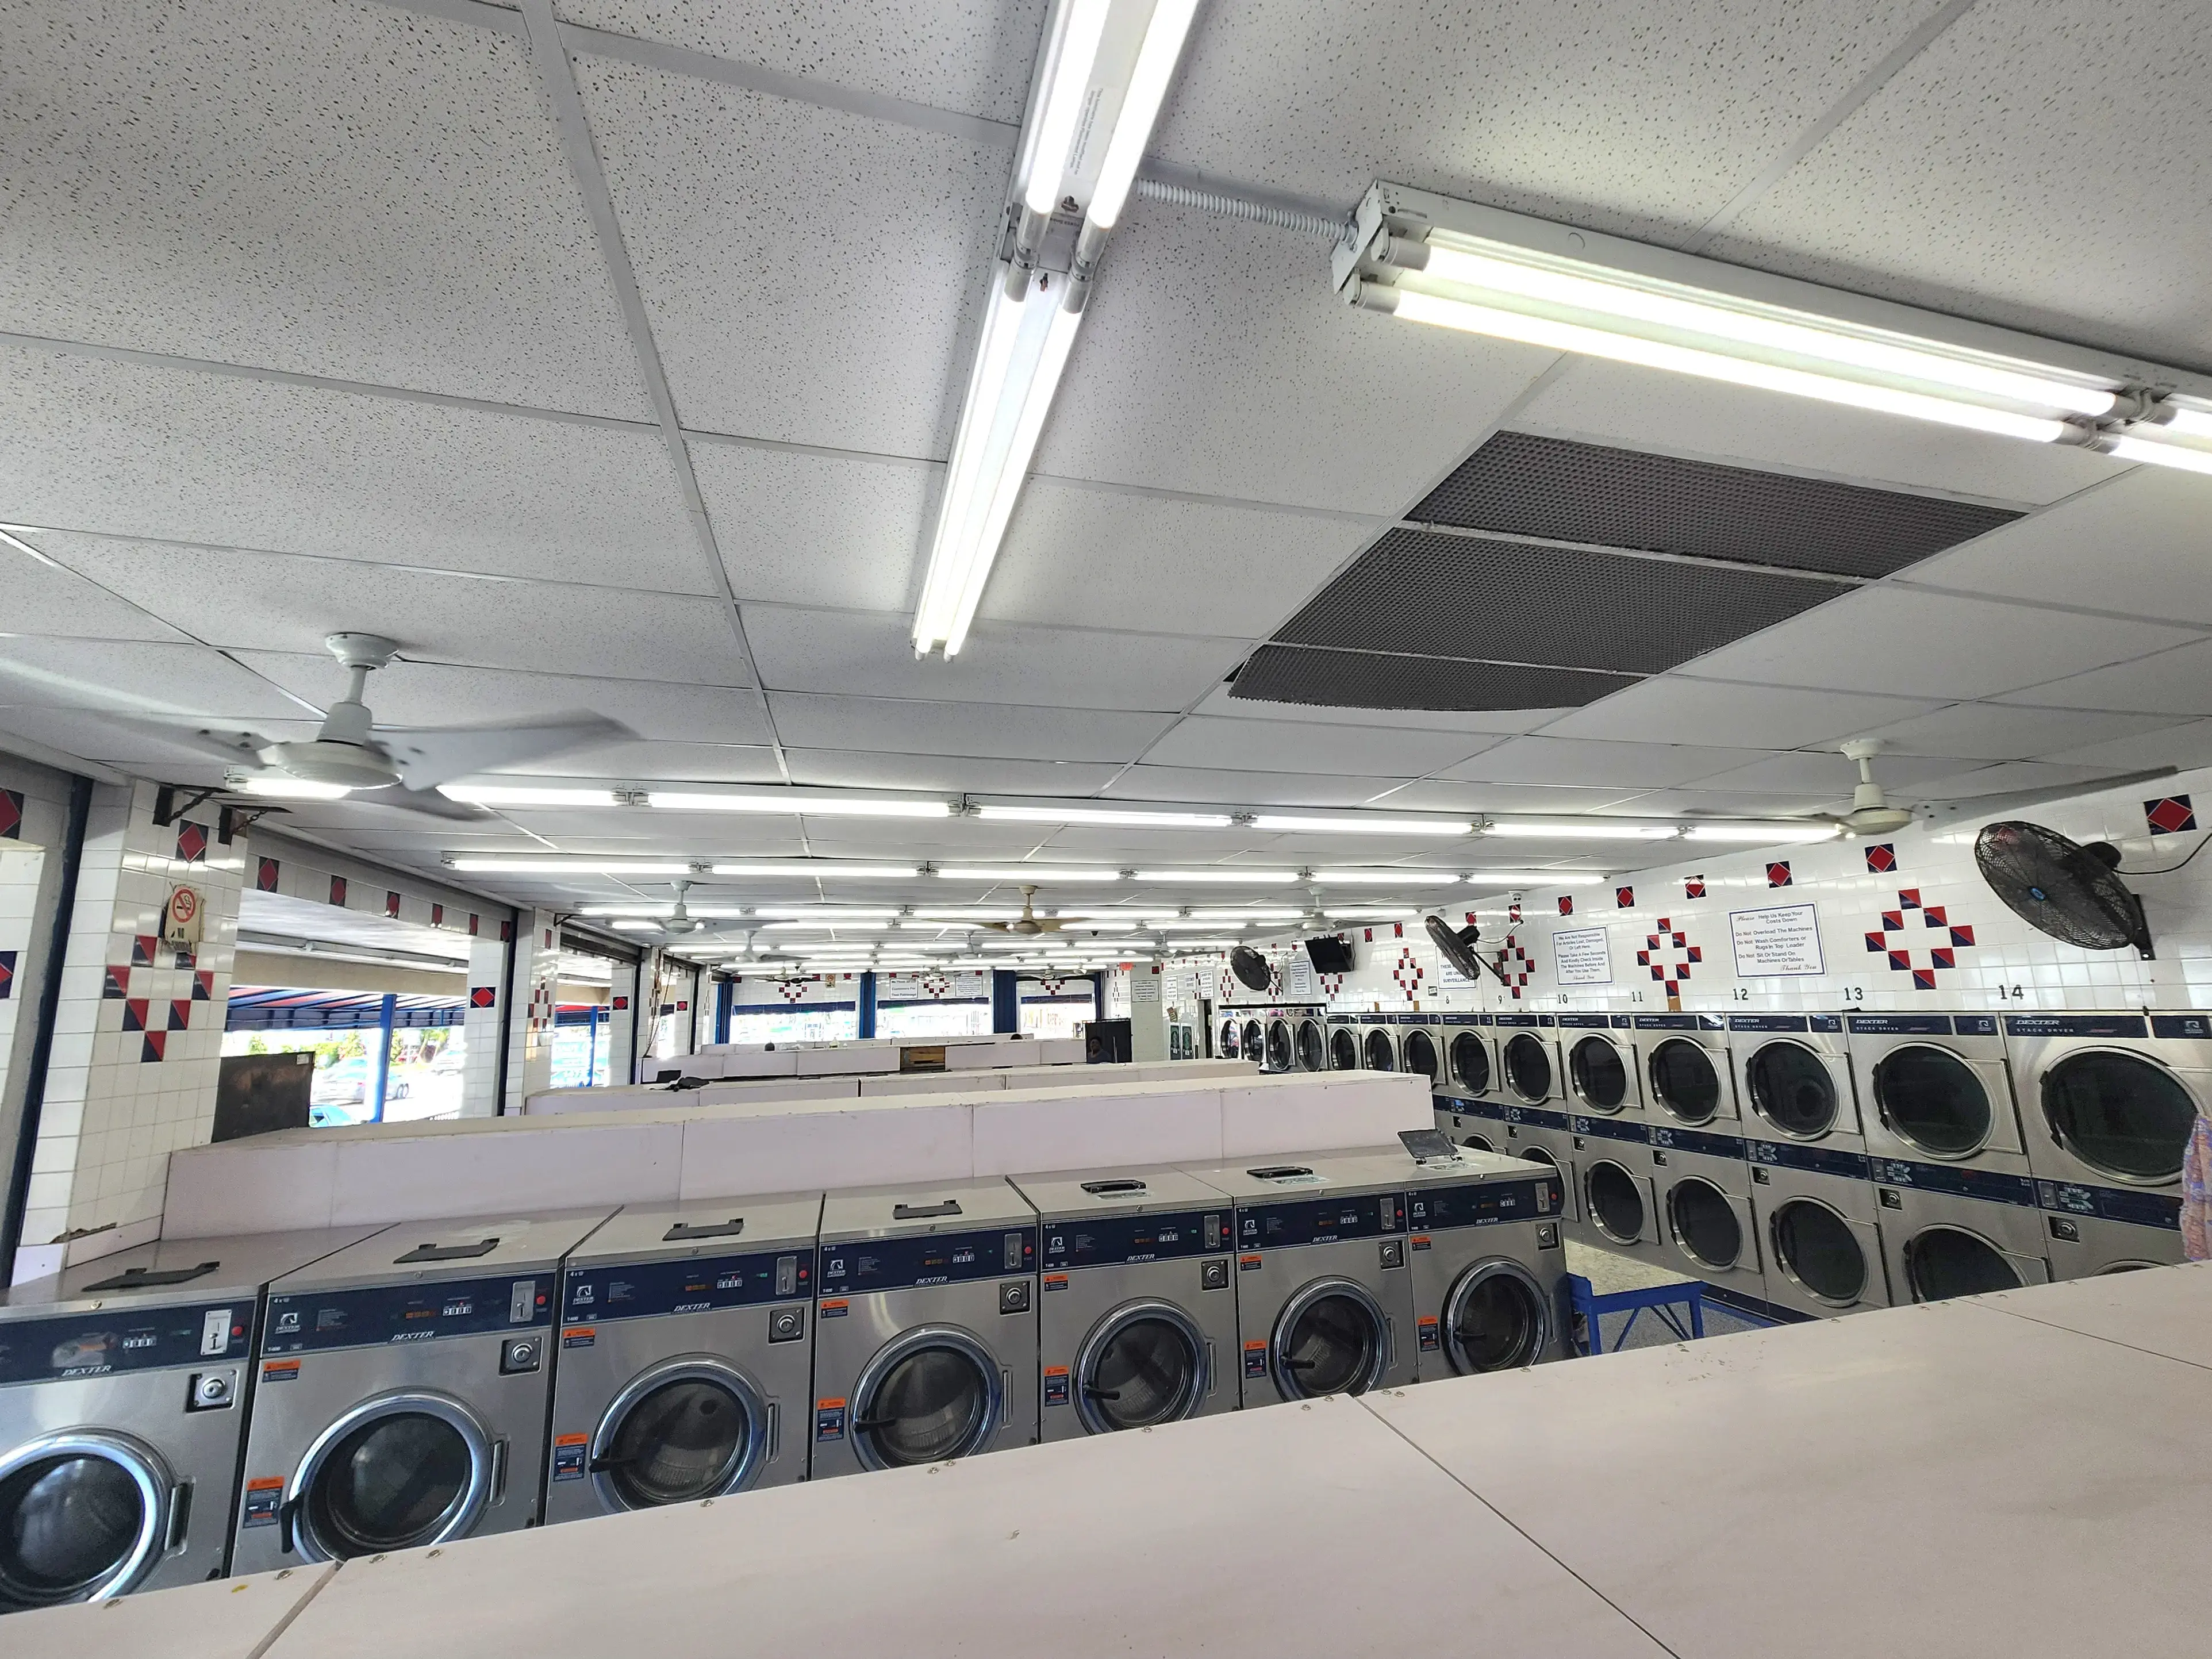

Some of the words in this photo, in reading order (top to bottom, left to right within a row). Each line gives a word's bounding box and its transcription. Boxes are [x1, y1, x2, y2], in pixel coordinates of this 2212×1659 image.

[1631, 991, 1643, 1002] 11
[1733, 989, 1749, 1000] 12
[1844, 987, 1863, 1001] 13
[1999, 984, 2024, 1000] 14
[1446, 996, 1449, 1004] 8
[1498, 995, 1502, 1004] 9
[1558, 994, 1568, 1004] 10
[915, 1276, 947, 1284] DEXTER
[674, 1303, 711, 1312] DEXTER
[391, 1331, 434, 1341] DEXTER
[62, 1365, 111, 1377] DEXTER
